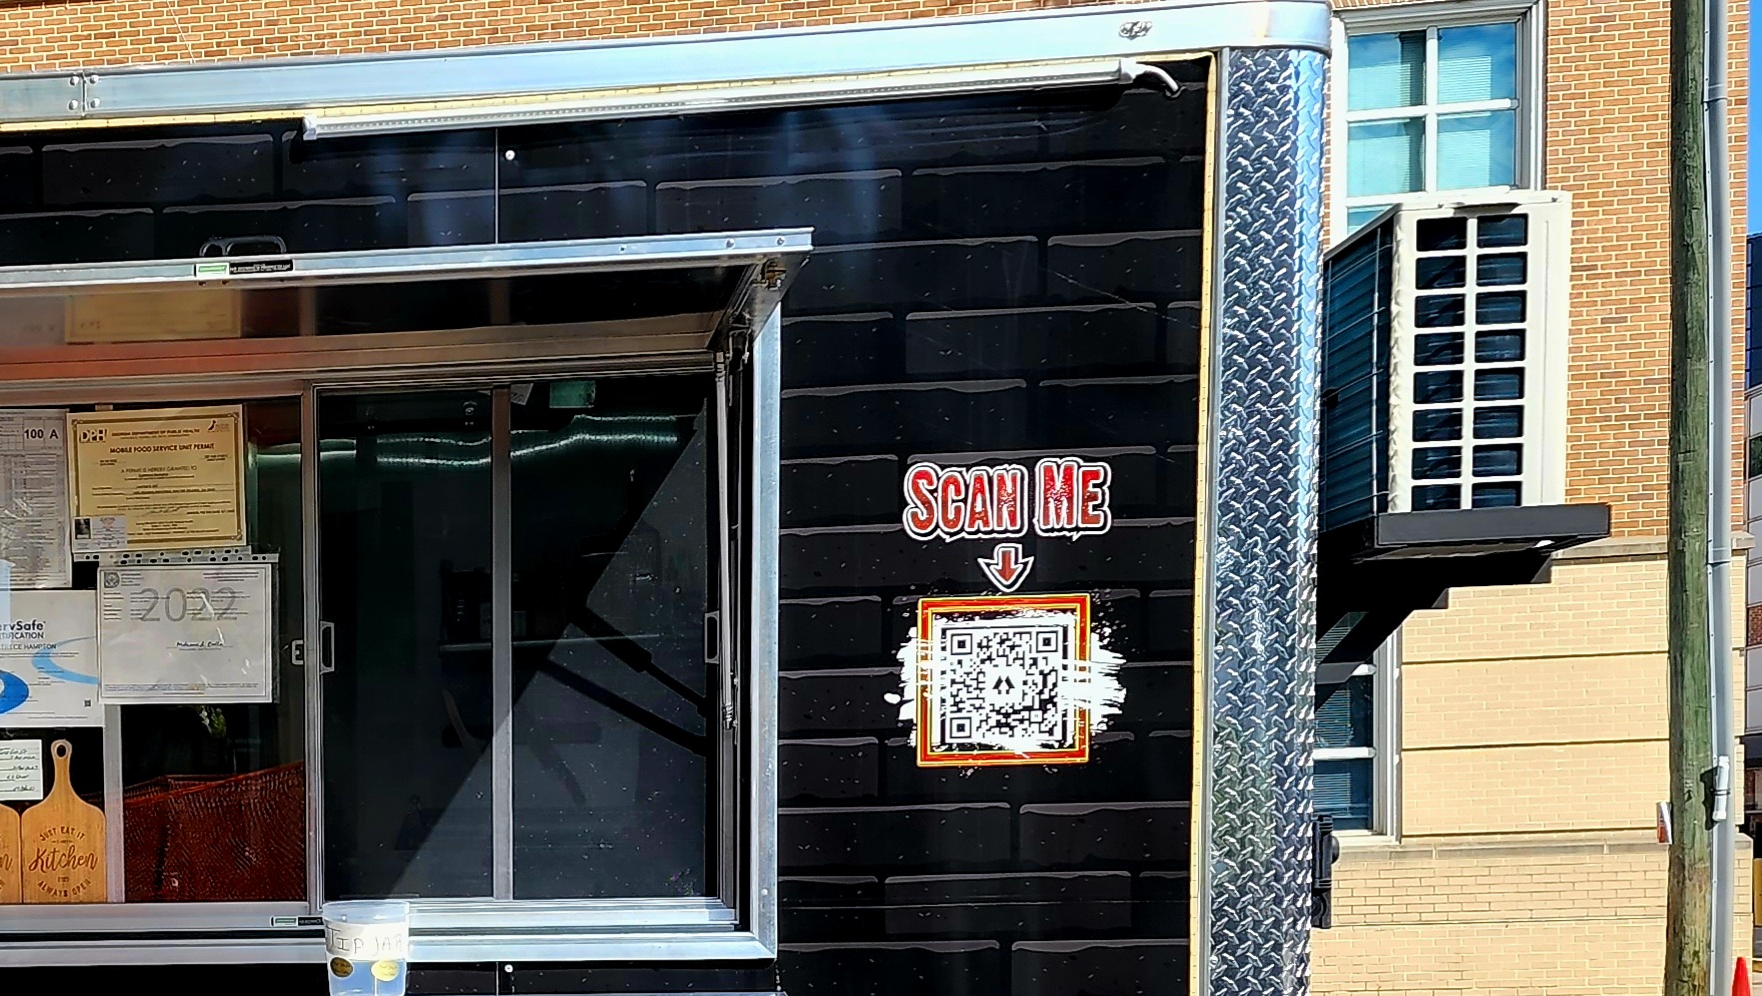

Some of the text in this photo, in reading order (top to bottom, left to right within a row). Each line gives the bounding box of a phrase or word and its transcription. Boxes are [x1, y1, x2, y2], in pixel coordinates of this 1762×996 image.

[24, 429, 58, 439] 100 A
[110, 446, 133, 454] MOBILE
[133, 445, 152, 453] FOOD
[153, 444, 178, 452] SERVICE
[178, 443, 192, 451] UNIT
[905, 459, 1110, 538] SCAN ME
[140, 586, 238, 622] 2022
[39, 826, 86, 841] JUST EAT IT
[28, 845, 98, 873] Kitchen
[38, 880, 68, 897] ALWAYS
[71, 878, 92, 895] OPEN
[326, 926, 364, 954] TIP
